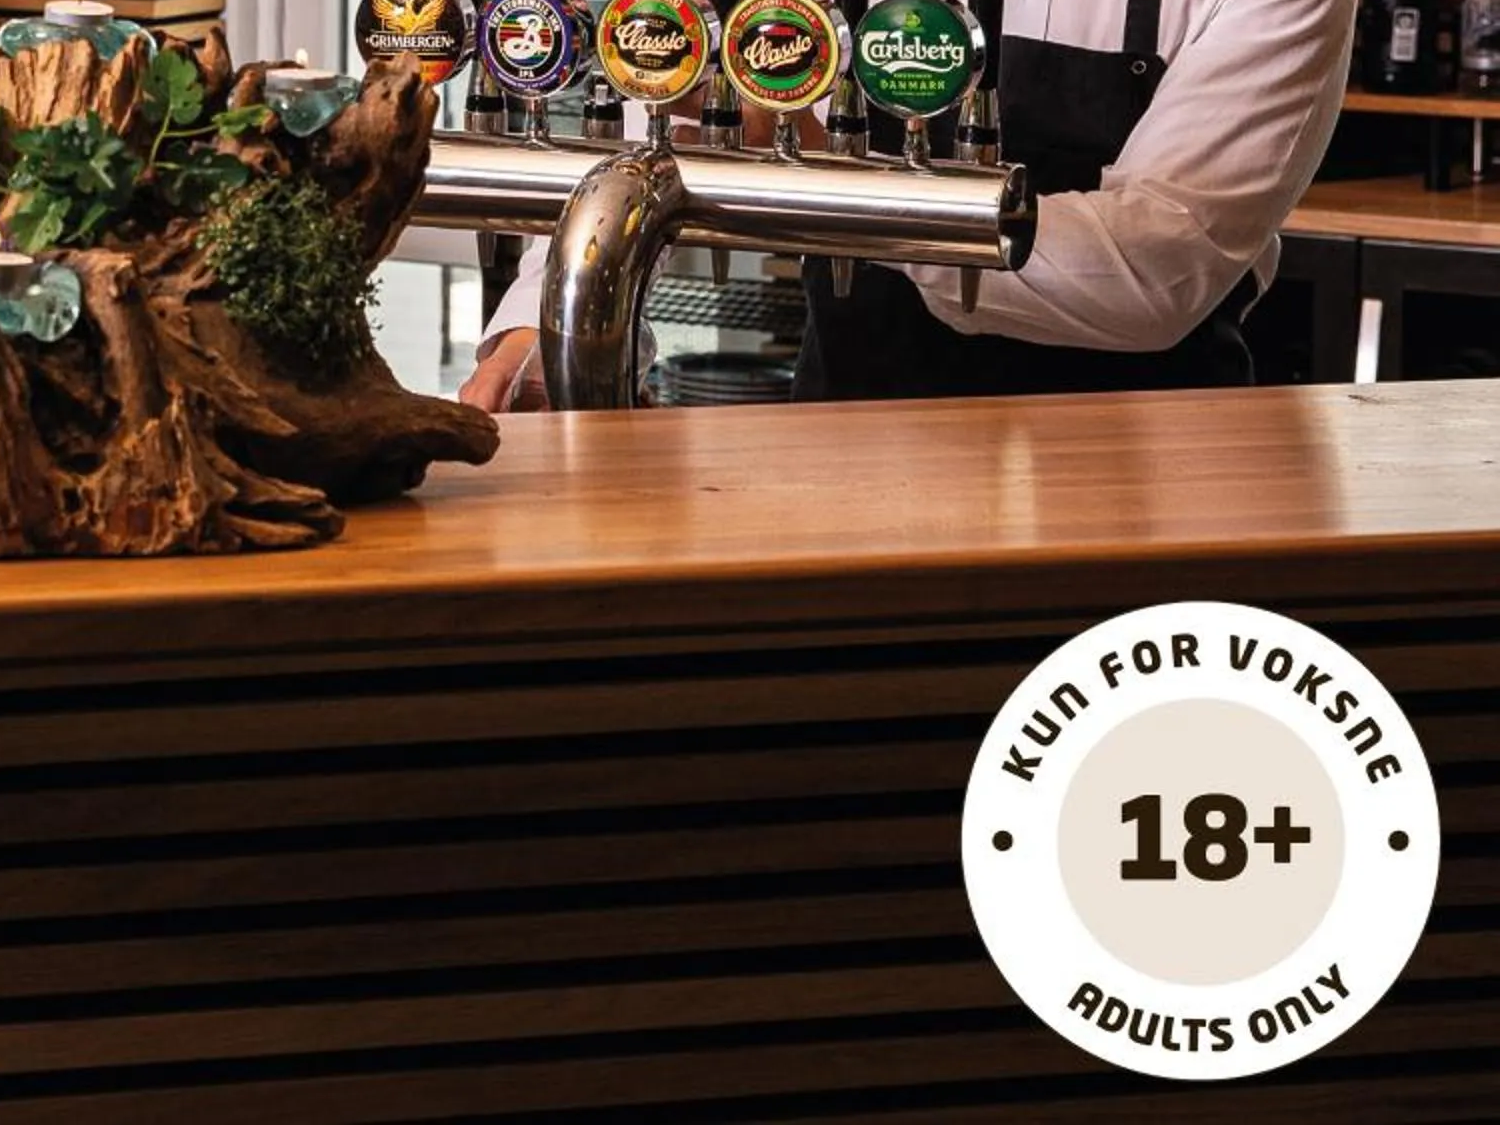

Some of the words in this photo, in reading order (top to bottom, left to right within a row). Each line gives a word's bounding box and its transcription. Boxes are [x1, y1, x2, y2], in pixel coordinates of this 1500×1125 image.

[369, 34, 452, 48] GRIMBERGEN
[615, 20, 687, 53] Classic
[743, 35, 813, 70] Classic
[861, 30, 965, 73] Carlsberg
[879, 78, 946, 90] DANMARK
